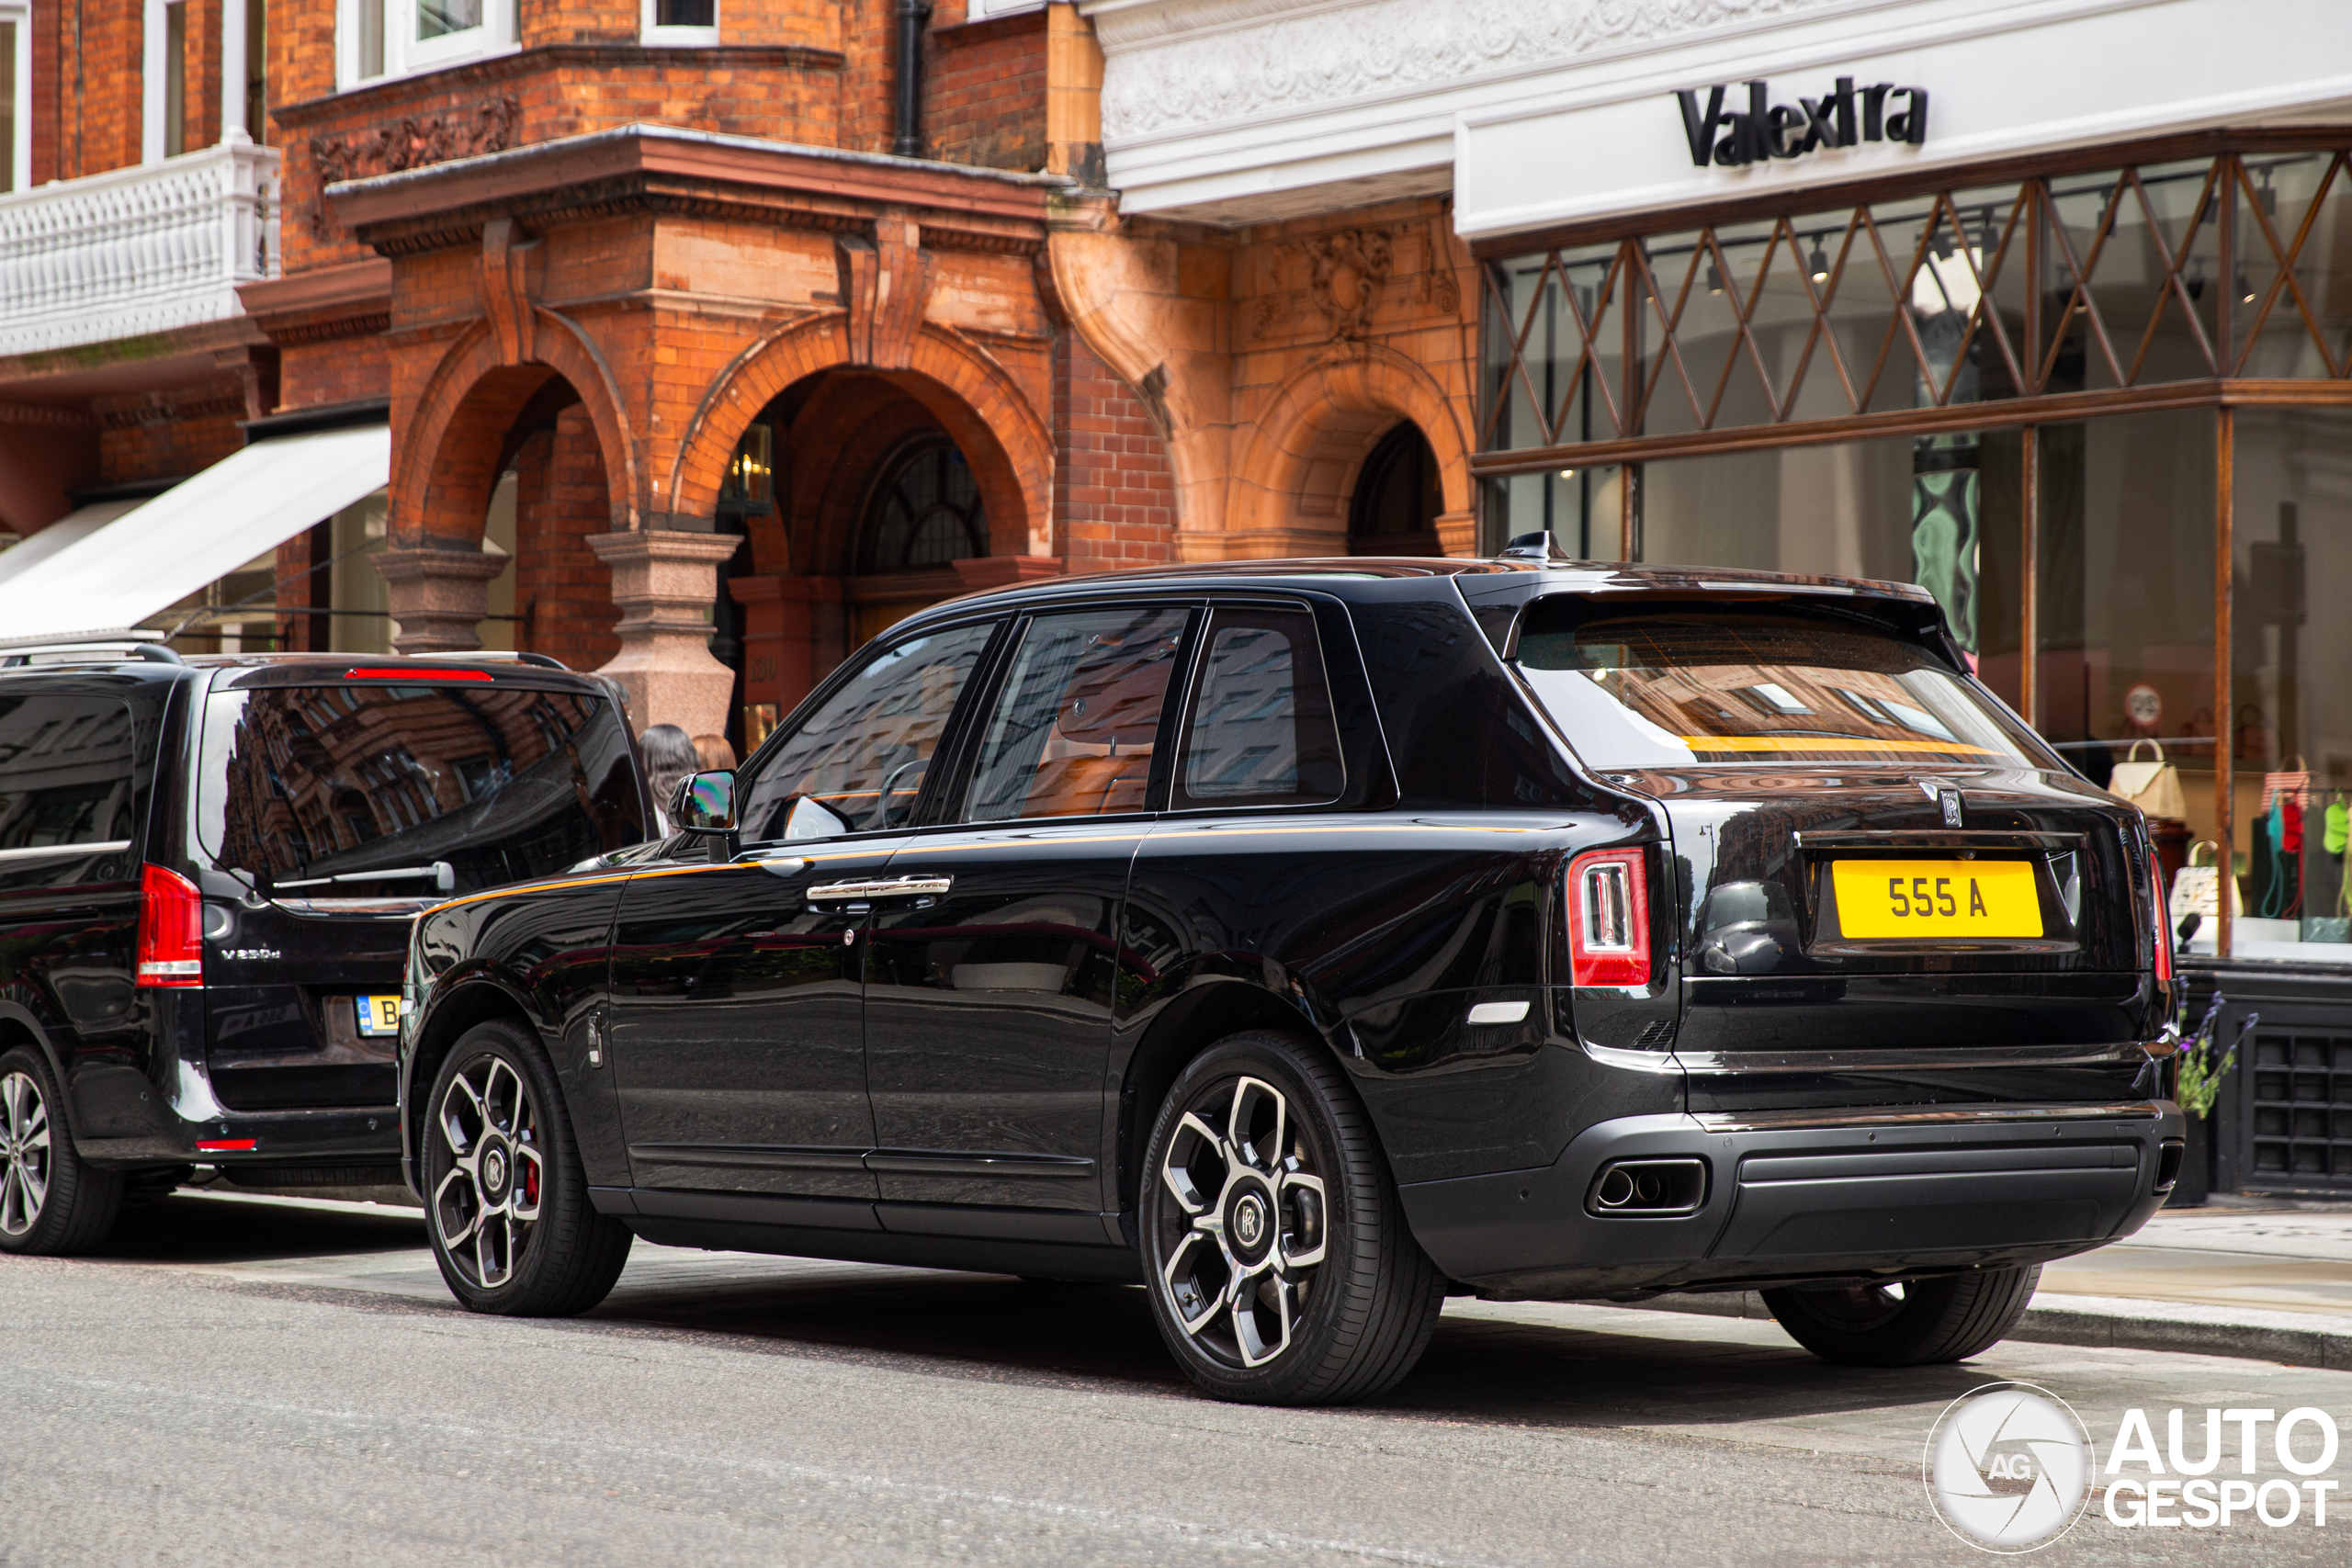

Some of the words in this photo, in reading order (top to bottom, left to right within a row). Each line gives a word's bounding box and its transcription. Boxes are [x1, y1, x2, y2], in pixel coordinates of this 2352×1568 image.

[1670, 74, 1928, 167] Valextra
[750, 655, 777, 682] 130
[1889, 877, 1957, 917] 555
[1969, 877, 1988, 917] A
